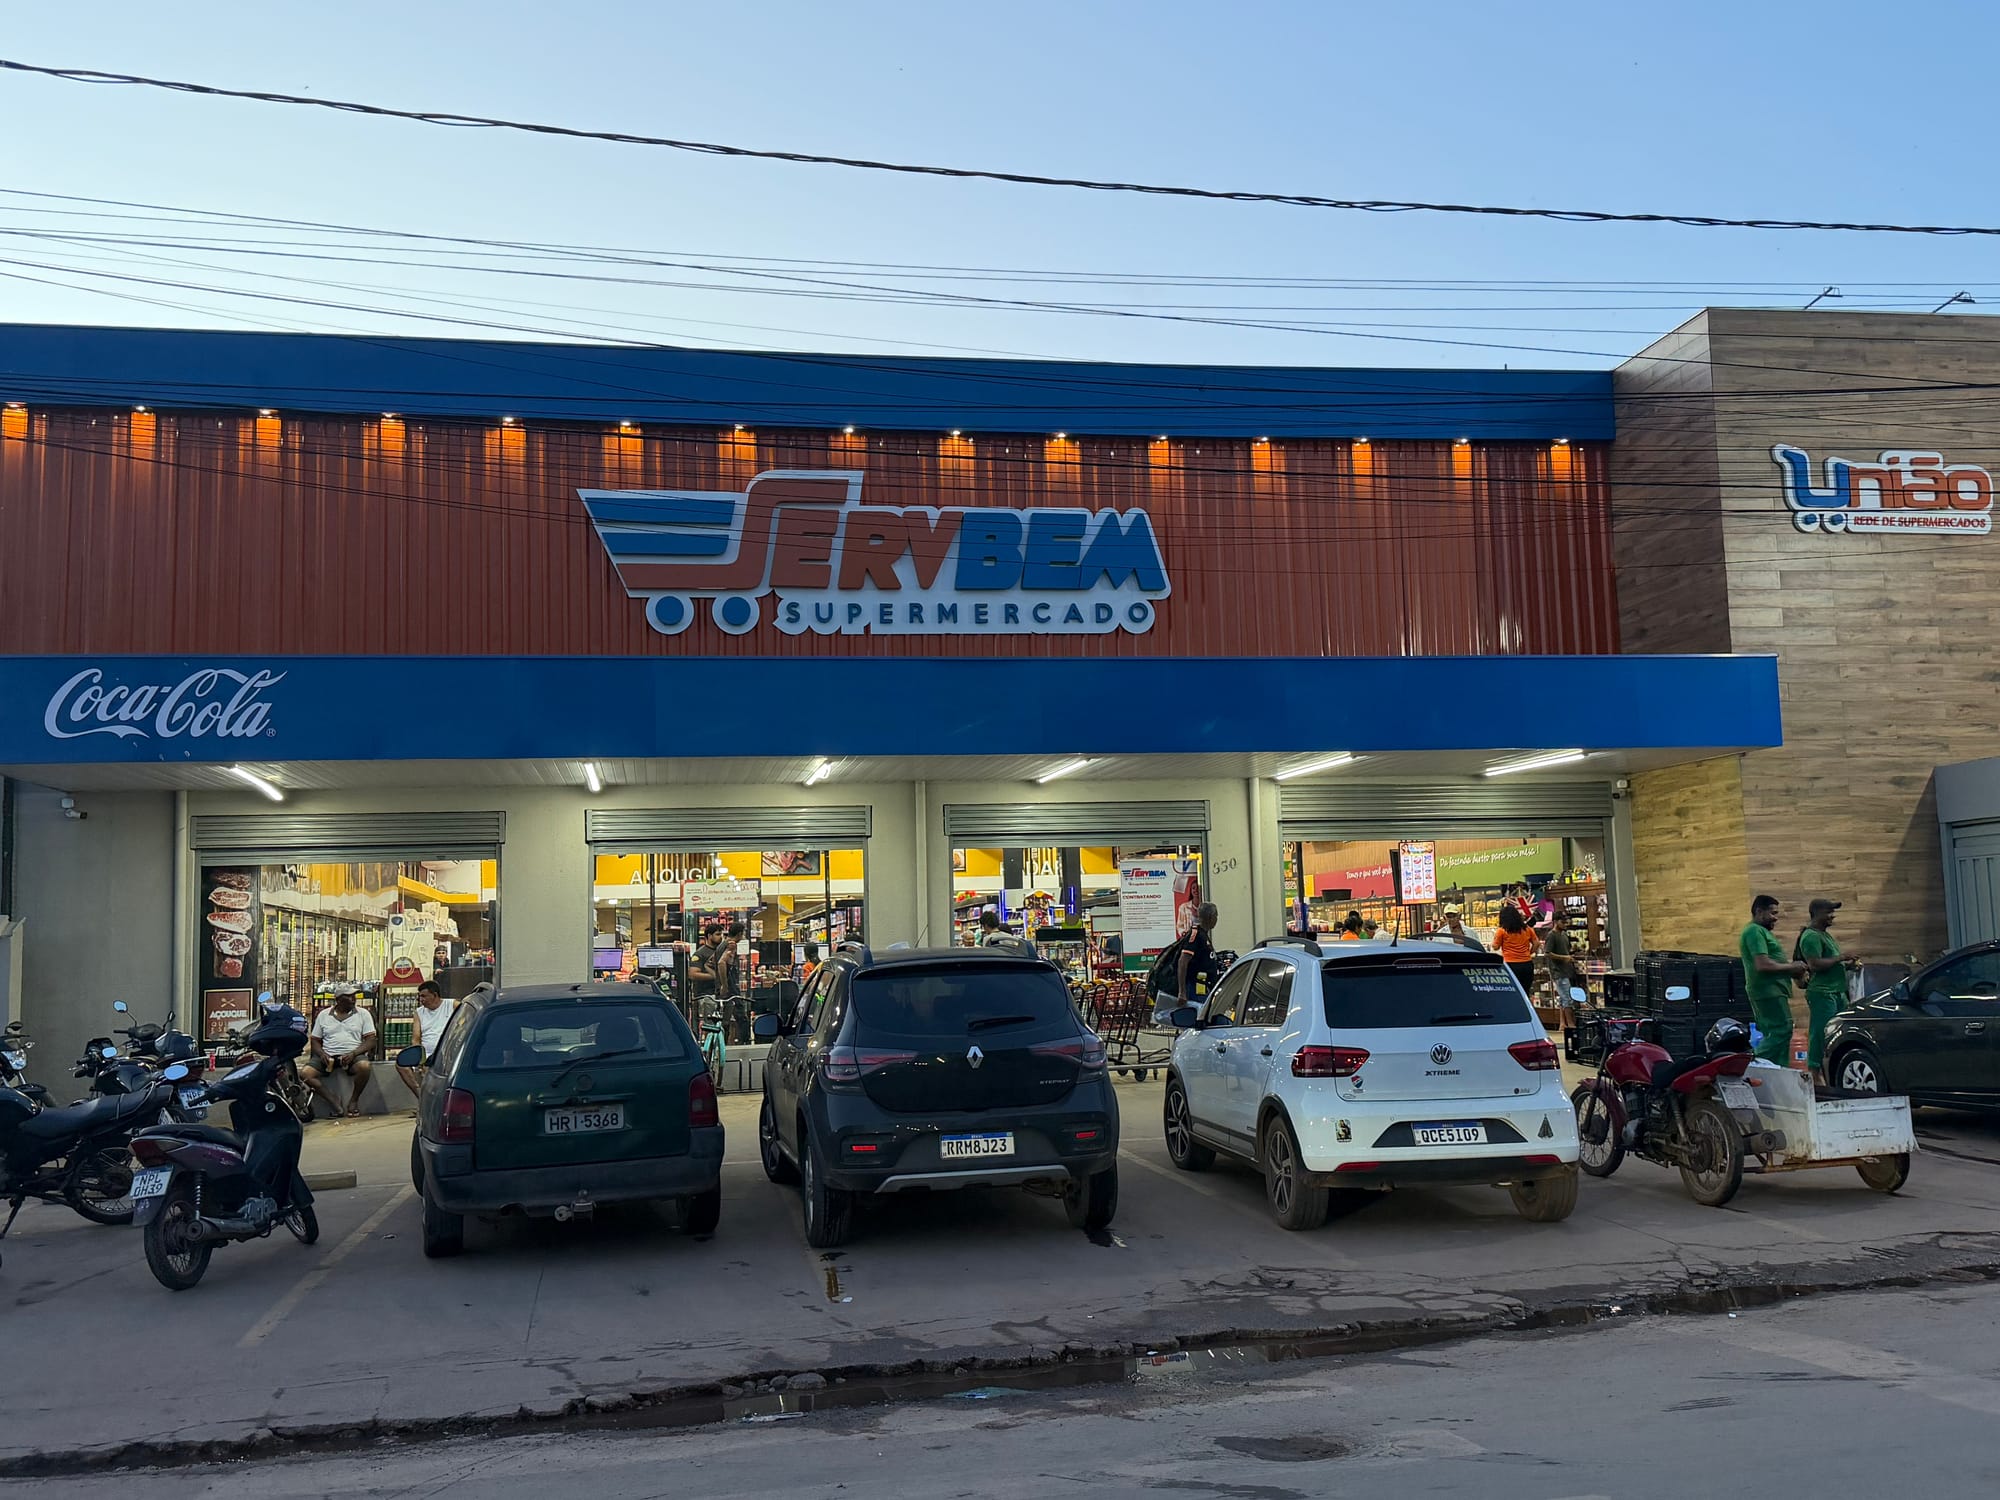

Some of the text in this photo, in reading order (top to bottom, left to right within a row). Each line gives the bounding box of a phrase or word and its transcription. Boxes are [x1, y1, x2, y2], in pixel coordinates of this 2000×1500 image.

[1854, 516, 1986, 528] REDE DE SUPERMERCADOS
[577, 472, 1169, 594] SERVBEM
[786, 602, 1149, 625] SUPERMERCADO
[45, 668, 288, 738] Coca-Cola
[947, 1138, 1007, 1155] RRM8J23
[139, 1173, 161, 1185] NPL
